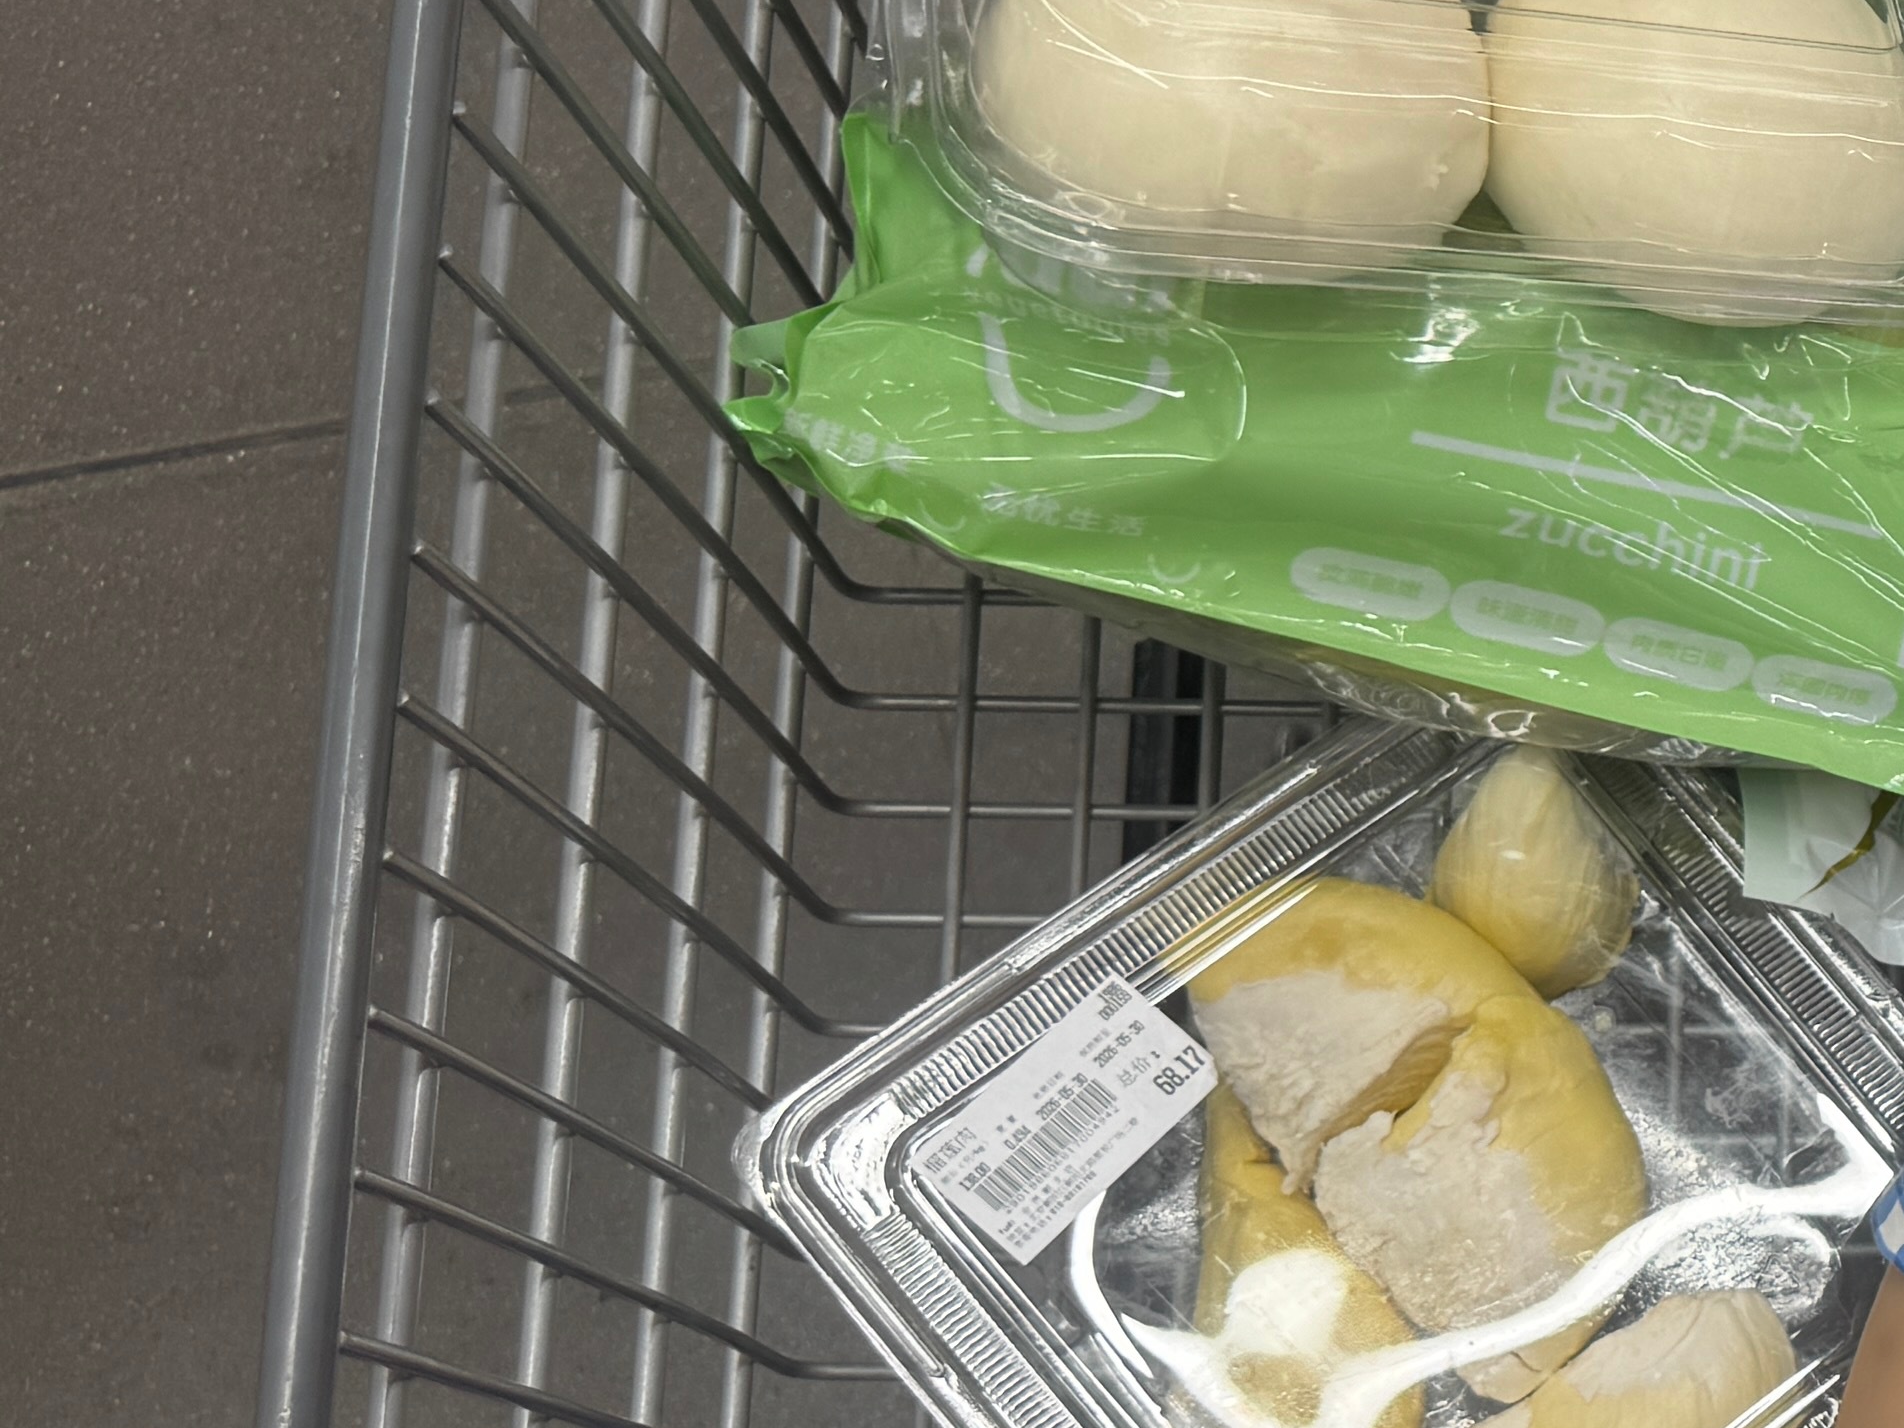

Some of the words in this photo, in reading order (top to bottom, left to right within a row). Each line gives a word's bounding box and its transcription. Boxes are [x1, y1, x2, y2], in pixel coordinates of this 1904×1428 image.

[1546, 348, 1814, 459] 西葫芦
[1500, 506, 1765, 592] zucchini
[1153, 1045, 1206, 1095] 68.17
